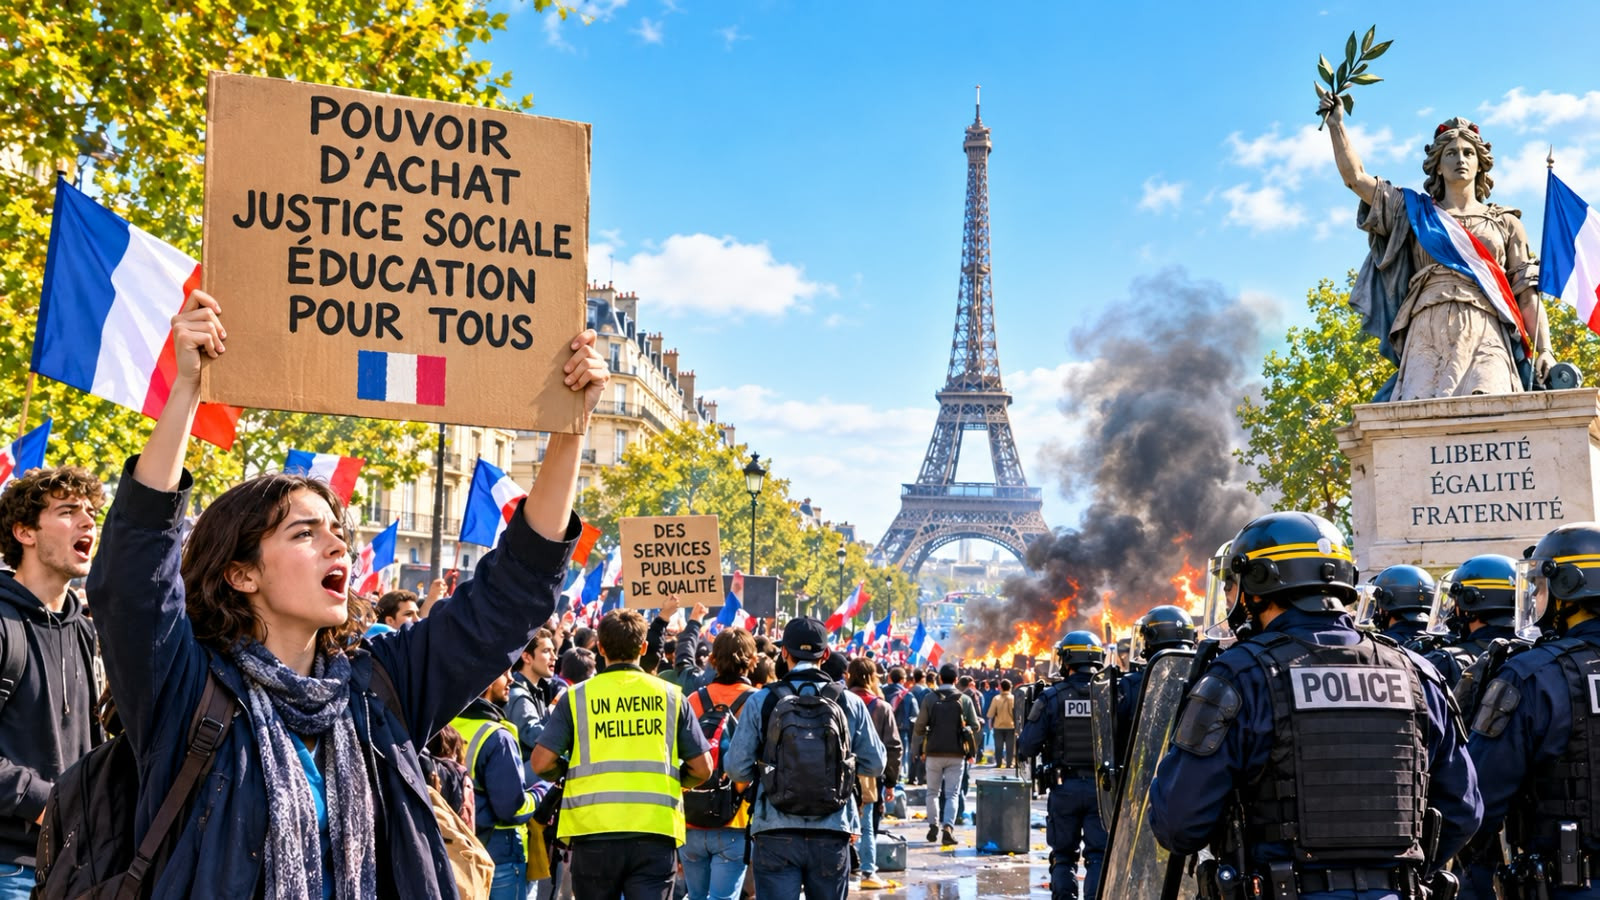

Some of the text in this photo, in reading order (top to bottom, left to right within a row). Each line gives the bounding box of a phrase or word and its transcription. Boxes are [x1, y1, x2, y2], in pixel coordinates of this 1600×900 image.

[310, 96, 512, 159] POUVOIR
[320, 145, 521, 206] D'ACHAT
[232, 189, 573, 260] JUSTICE SOCIALE
[287, 235, 536, 305] ÉDUCATION
[289, 295, 535, 351] POUR TOUS
[1430, 436, 1532, 465] LIBERTÉ
[1430, 466, 1536, 495] ÉGALITÉ
[1411, 496, 1565, 526] FRATERNITÉ
[653, 523, 686, 539] DES
[633, 541, 712, 559] SERVICES
[641, 560, 706, 578] PUBLICS
[631, 575, 717, 597] DE QUALITÉ
[1300, 671, 1406, 703] POLICE
[590, 695, 665, 715] UN AVENIR
[1068, 702, 1091, 715] POL
[594, 718, 664, 740] MEILLEUR
